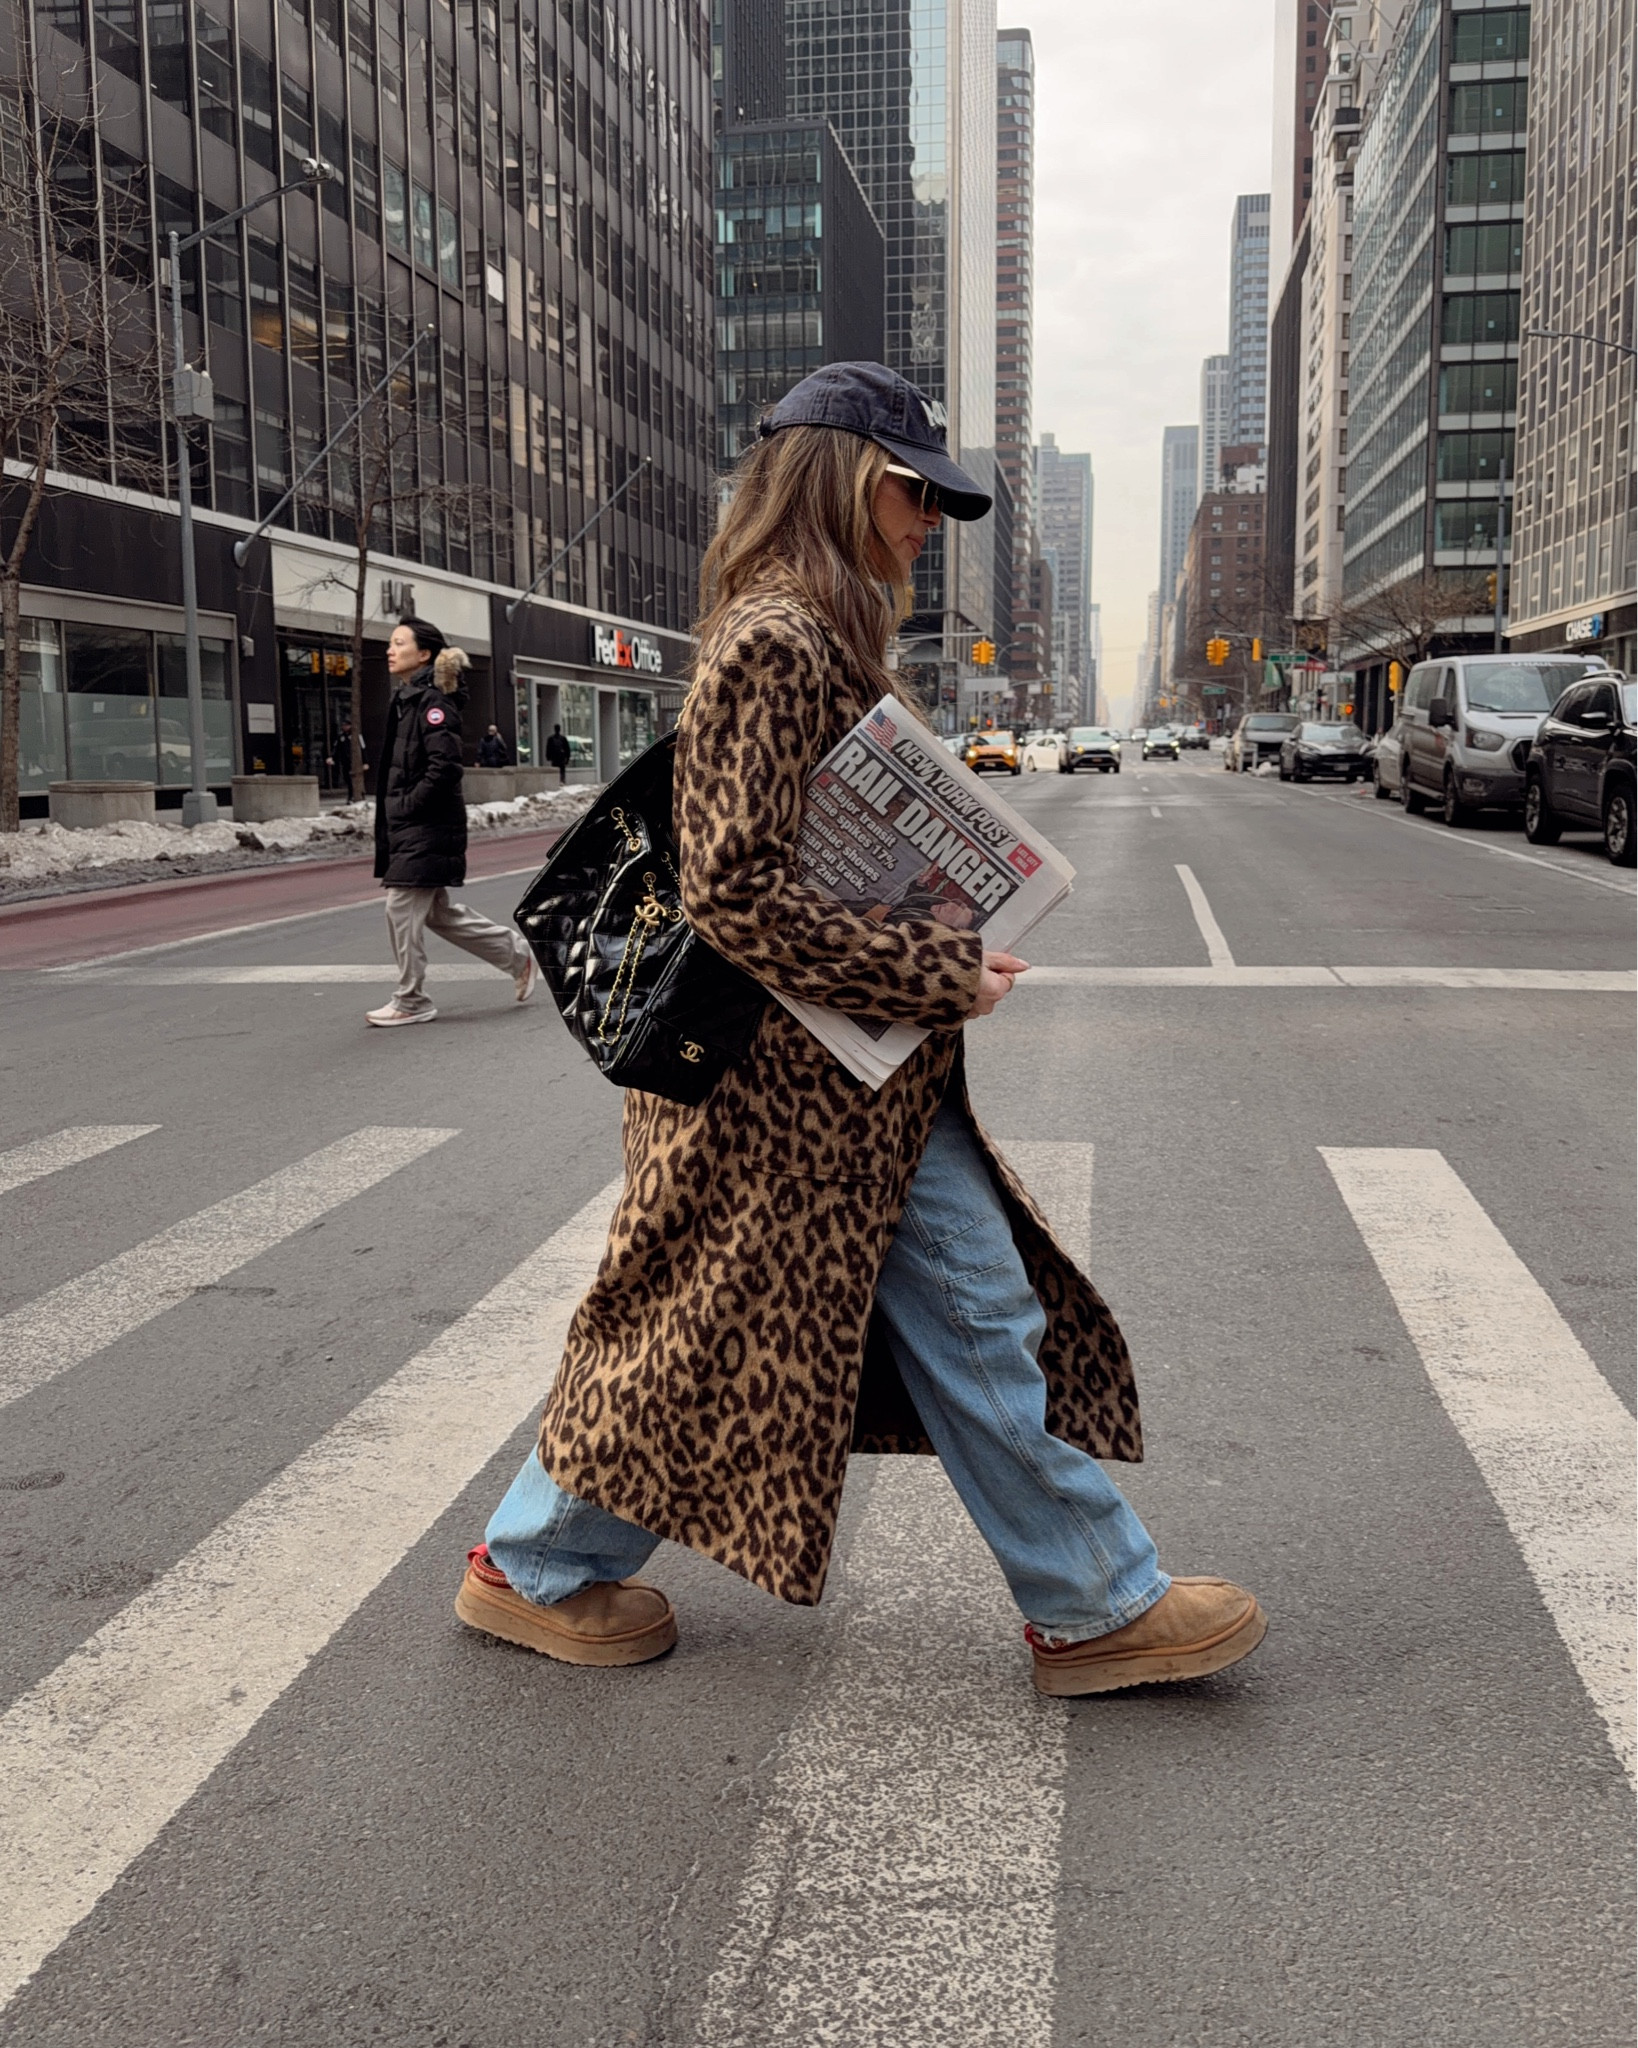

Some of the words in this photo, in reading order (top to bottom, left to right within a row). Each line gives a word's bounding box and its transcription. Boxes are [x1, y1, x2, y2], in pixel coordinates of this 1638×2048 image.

[594, 625, 633, 668] FedEx
[631, 636, 662, 673] Office
[1566, 617, 1592, 642] CHASE
[827, 783, 861, 815] Major
[860, 811, 897, 848] transit
[830, 740, 904, 817] RAIL
[892, 798, 1011, 913] DANGER
[891, 739, 941, 779] NEW
[925, 768, 981, 817] YORK
[963, 807, 1018, 849] POST
[804, 810, 844, 849] Maniac
[842, 846, 880, 882] shoves
[806, 786, 838, 817] crime
[837, 814, 873, 848] spikes
[871, 844, 897, 870] 17%
[815, 863, 840, 887] 2nd
[821, 848, 838, 865] on
[835, 860, 867, 894] track,
